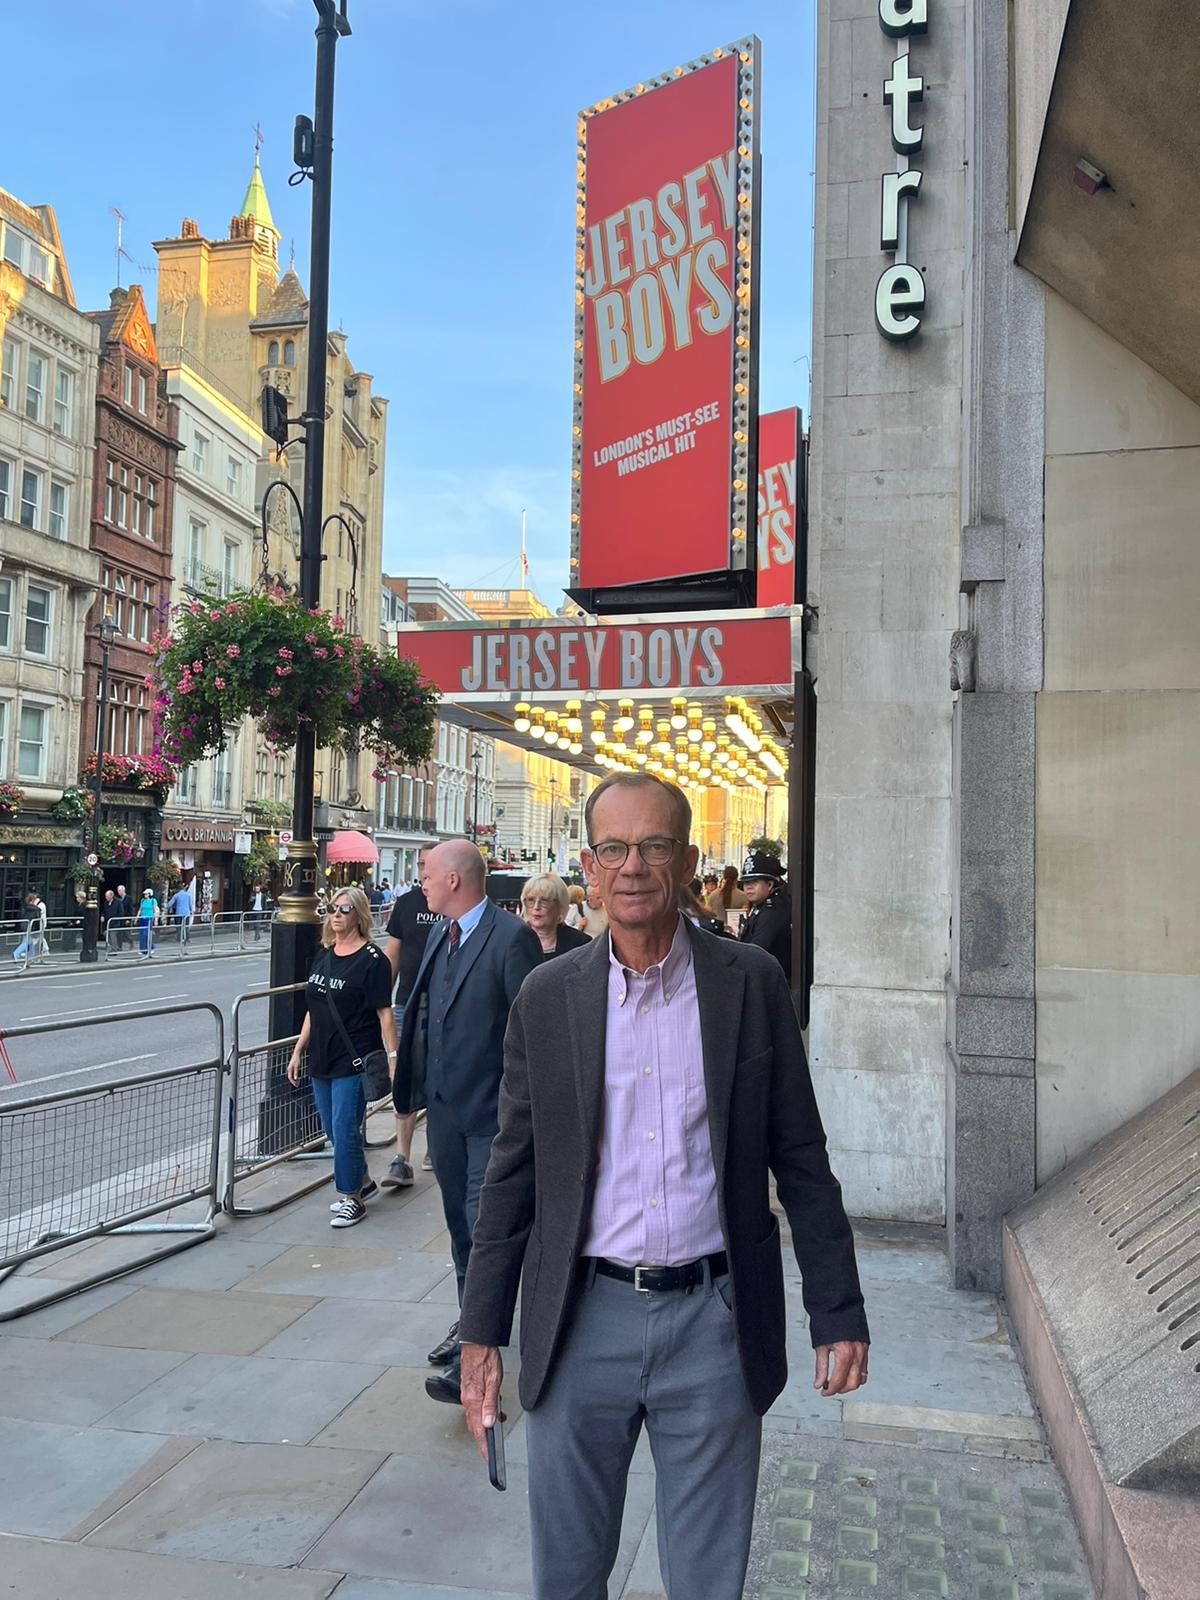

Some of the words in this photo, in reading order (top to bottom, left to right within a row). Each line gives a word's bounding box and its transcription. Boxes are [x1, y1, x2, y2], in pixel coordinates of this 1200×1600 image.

[585, 149, 735, 298] JERSEY
[593, 240, 733, 383] BOYS
[593, 428, 654, 467] LONDON'S
[655, 401, 720, 442] MUST-SEE
[617, 441, 673, 477] MUSICAL
[674, 430, 697, 454] HIT
[461, 631, 607, 691] JERSEY
[620, 627, 724, 688] BOYS
[166, 827, 193, 841] COOL
[194, 828, 234, 843] BRITANNIA
[416, 912, 443, 922] POLO
